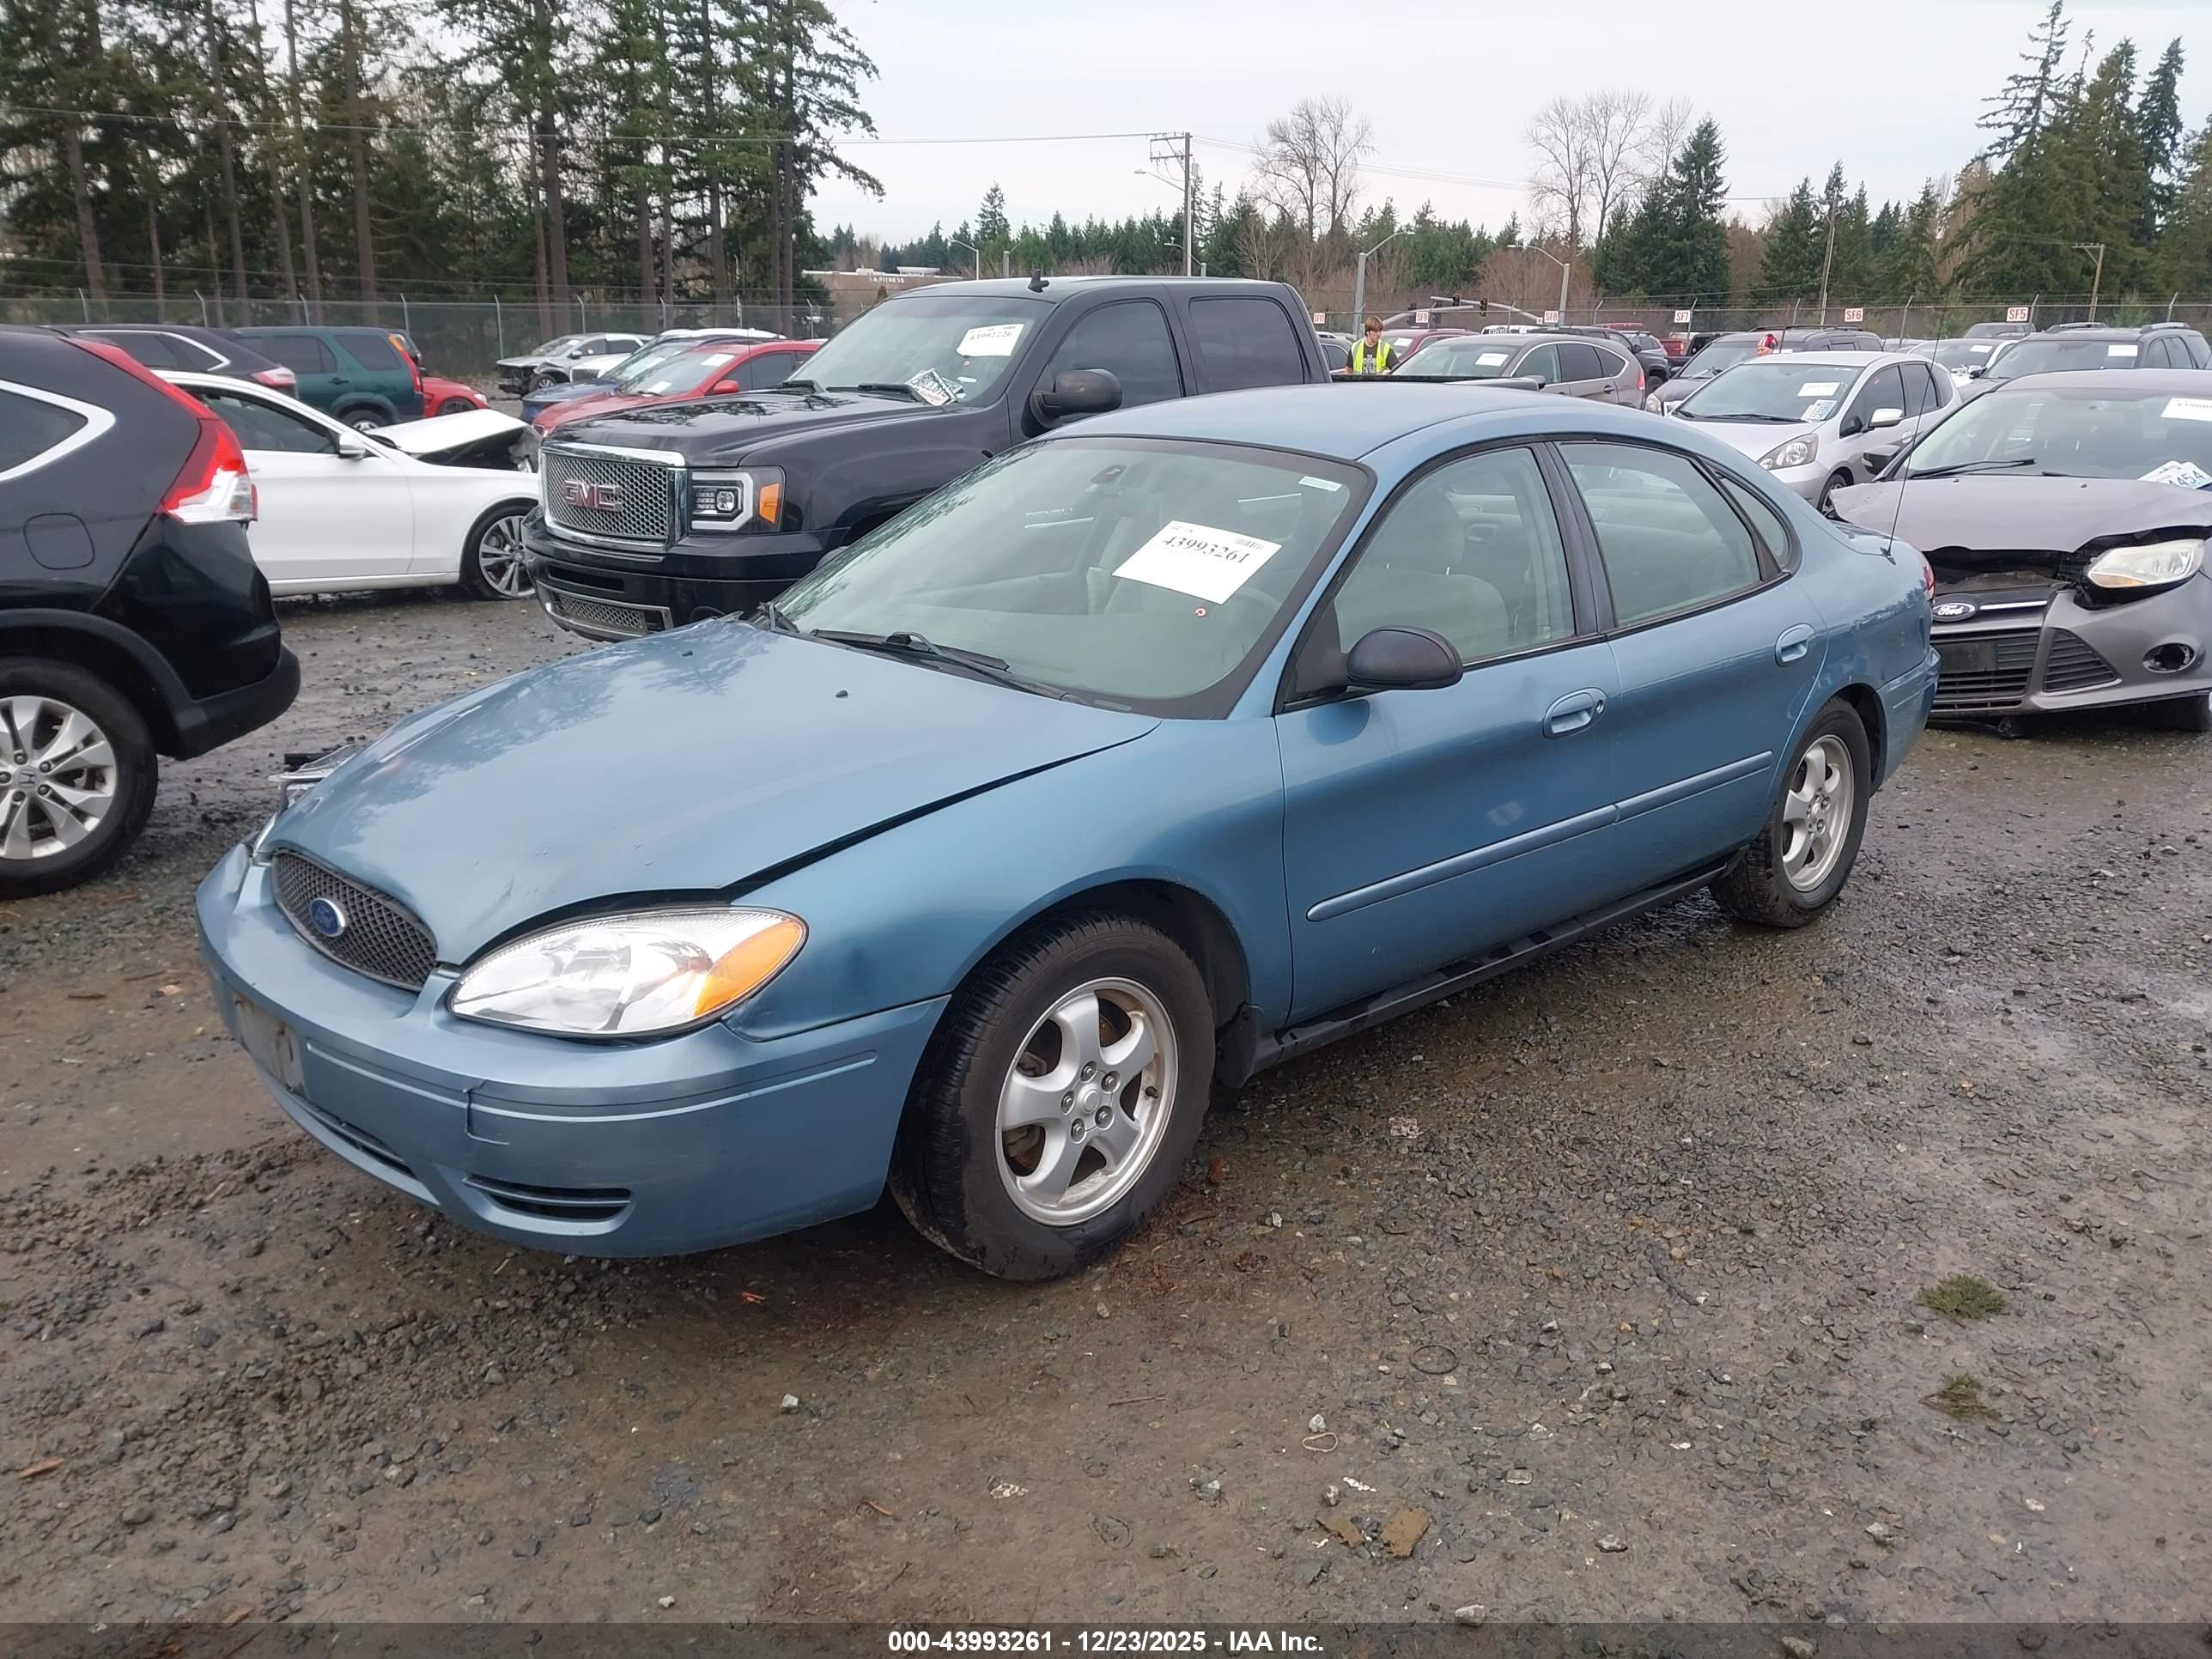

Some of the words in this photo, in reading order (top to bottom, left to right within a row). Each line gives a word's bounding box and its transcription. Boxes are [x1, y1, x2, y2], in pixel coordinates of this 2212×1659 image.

[1417, 313, 1428, 322] SF9
[1546, 312, 1558, 322] SF8
[1676, 312, 1689, 322] SF7
[1846, 309, 1862, 320] SF6
[2008, 308, 2027, 319] SF5
[563, 480, 621, 512] GMC
[1162, 535, 1250, 564] 43993261
[1937, 605, 1965, 616] Ford
